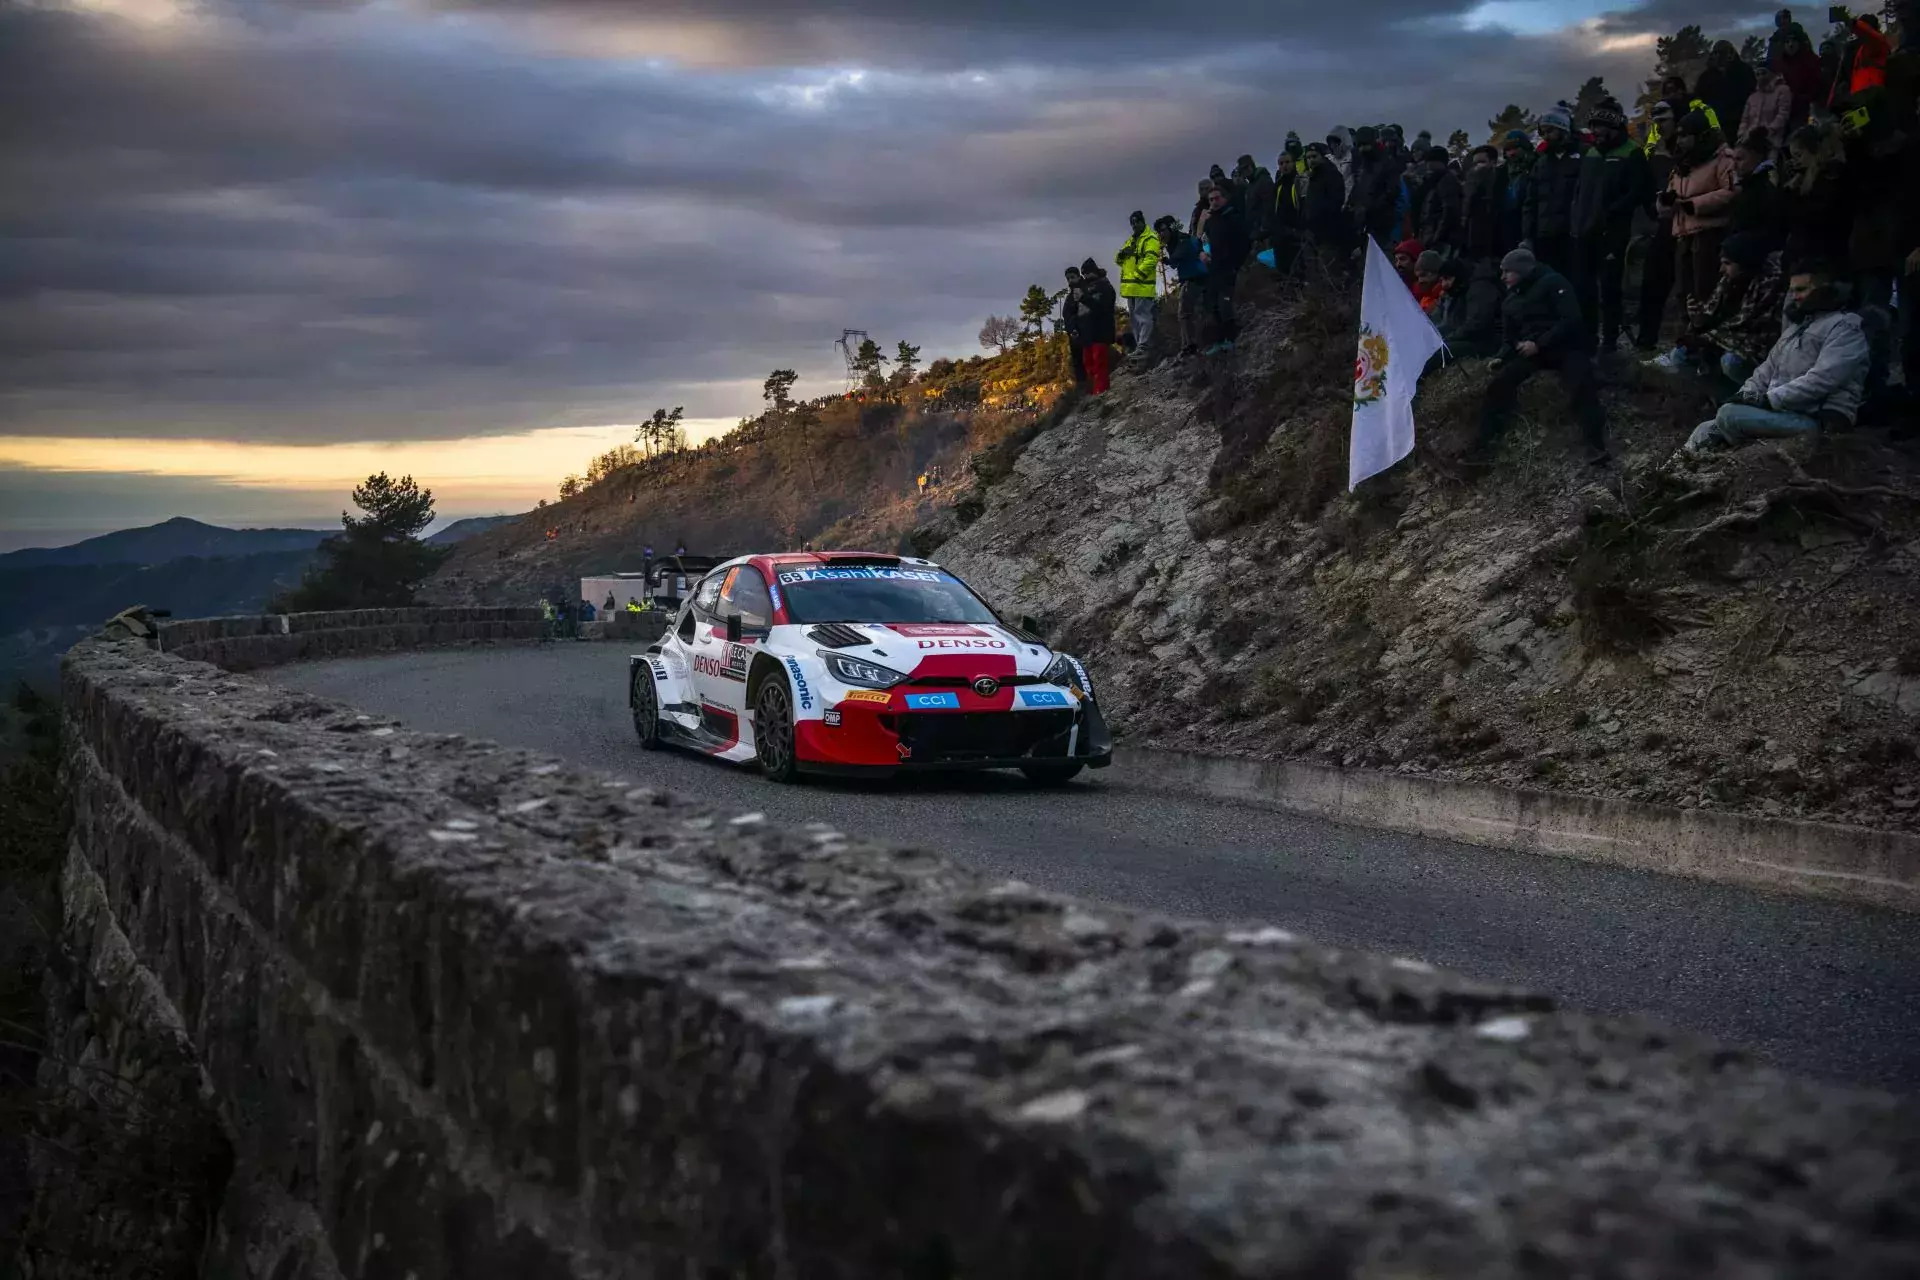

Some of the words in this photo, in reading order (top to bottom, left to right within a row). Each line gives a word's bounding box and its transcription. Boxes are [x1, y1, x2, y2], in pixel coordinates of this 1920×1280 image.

[781, 572, 803, 583] 69
[917, 640, 1006, 649] DENSO
[694, 654, 720, 677] DENSO
[1062, 653, 1094, 702] Panaso
[848, 690, 889, 702] PIRELLI
[825, 712, 841, 723] OMP
